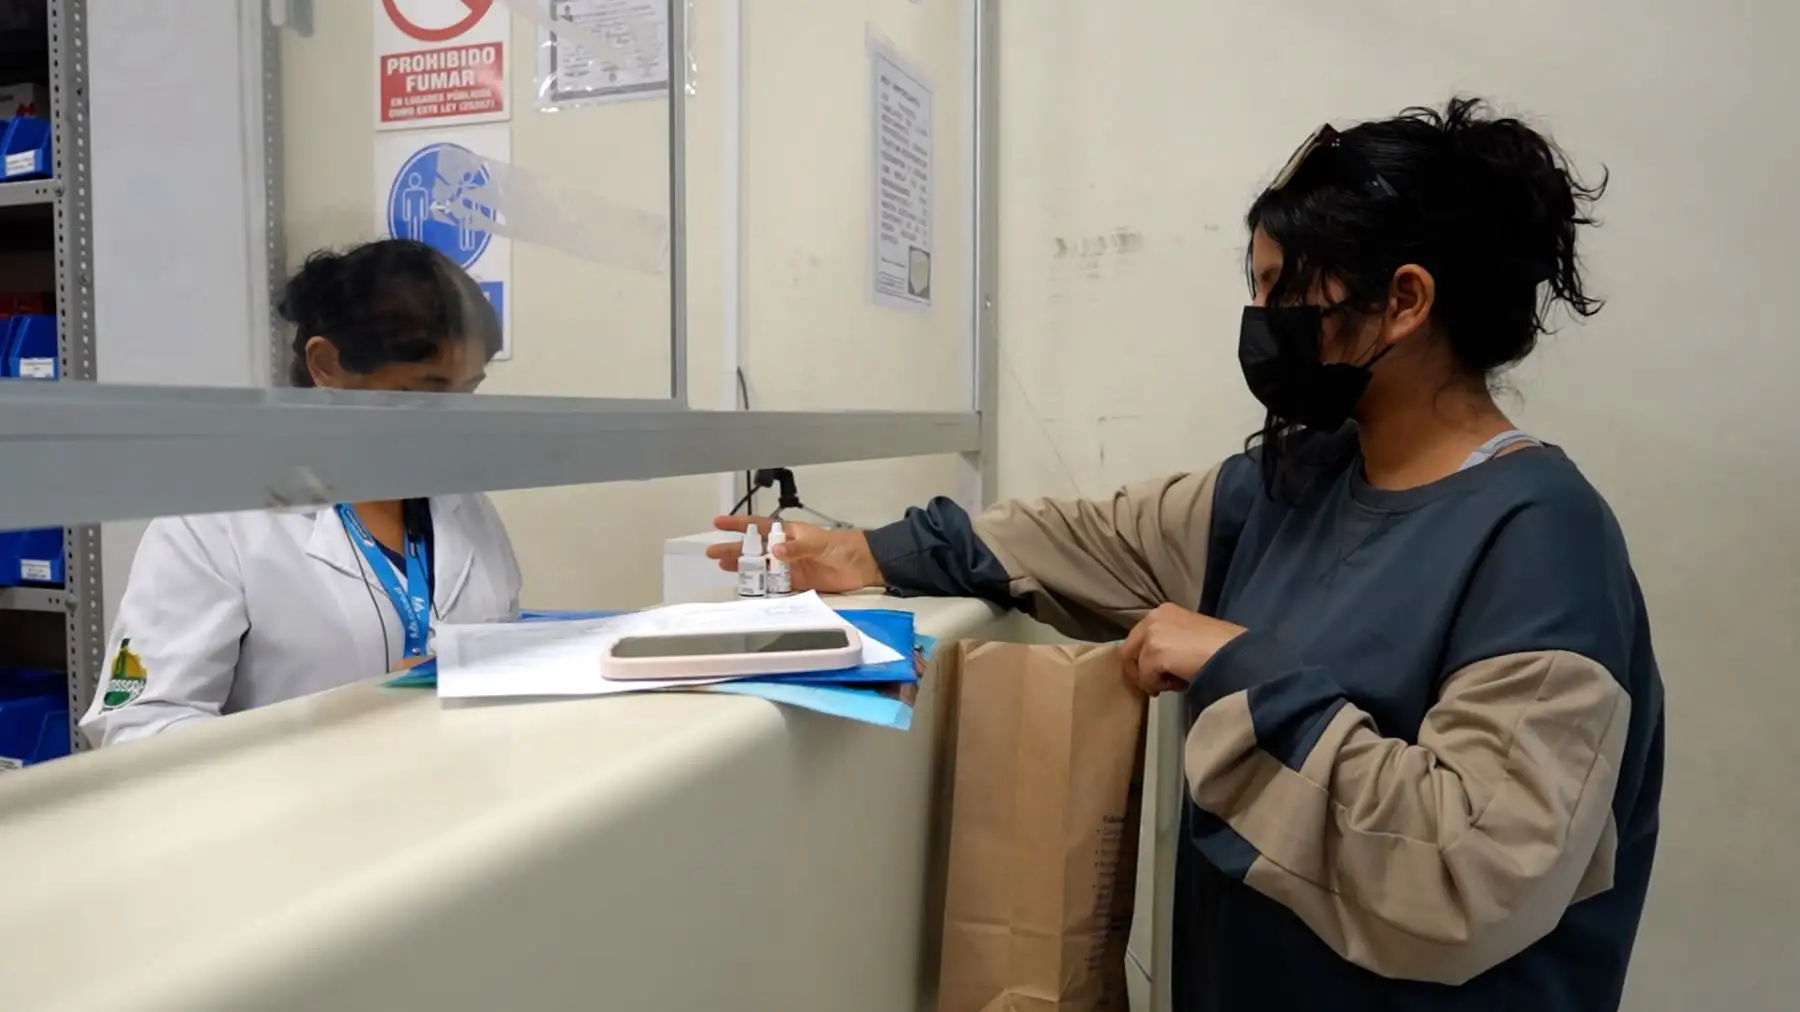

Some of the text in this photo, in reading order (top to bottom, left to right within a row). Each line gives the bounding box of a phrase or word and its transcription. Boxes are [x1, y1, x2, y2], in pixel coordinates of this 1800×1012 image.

[387, 46, 495, 75] PROHIBIDO
[406, 70, 474, 93] FUMAR
[391, 97, 404, 107] EN
[440, 102, 457, 113] LEY
